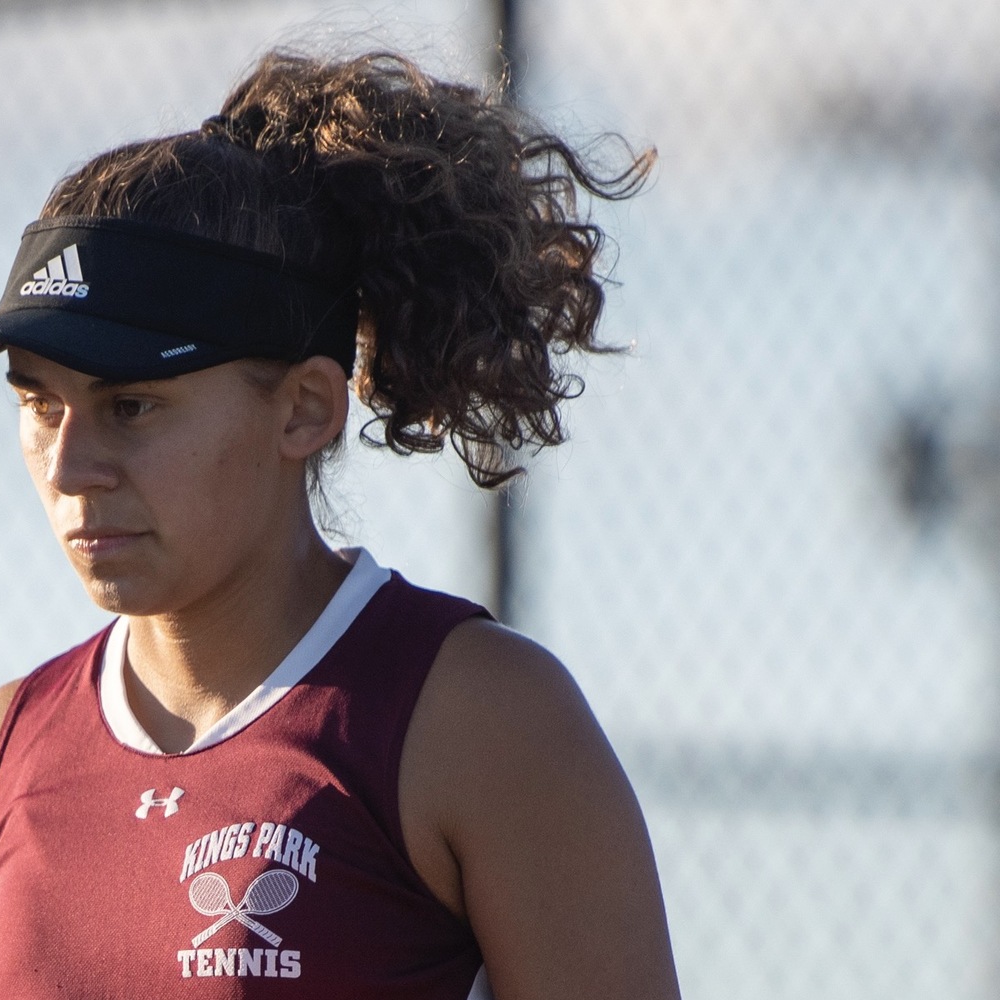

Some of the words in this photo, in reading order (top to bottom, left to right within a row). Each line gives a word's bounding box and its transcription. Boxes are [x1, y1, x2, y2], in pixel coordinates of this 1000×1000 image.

[20, 279, 90, 297] adidas
[180, 822, 255, 883] KINGS
[253, 822, 320, 883] PARK
[177, 948, 301, 978] TENNIS
